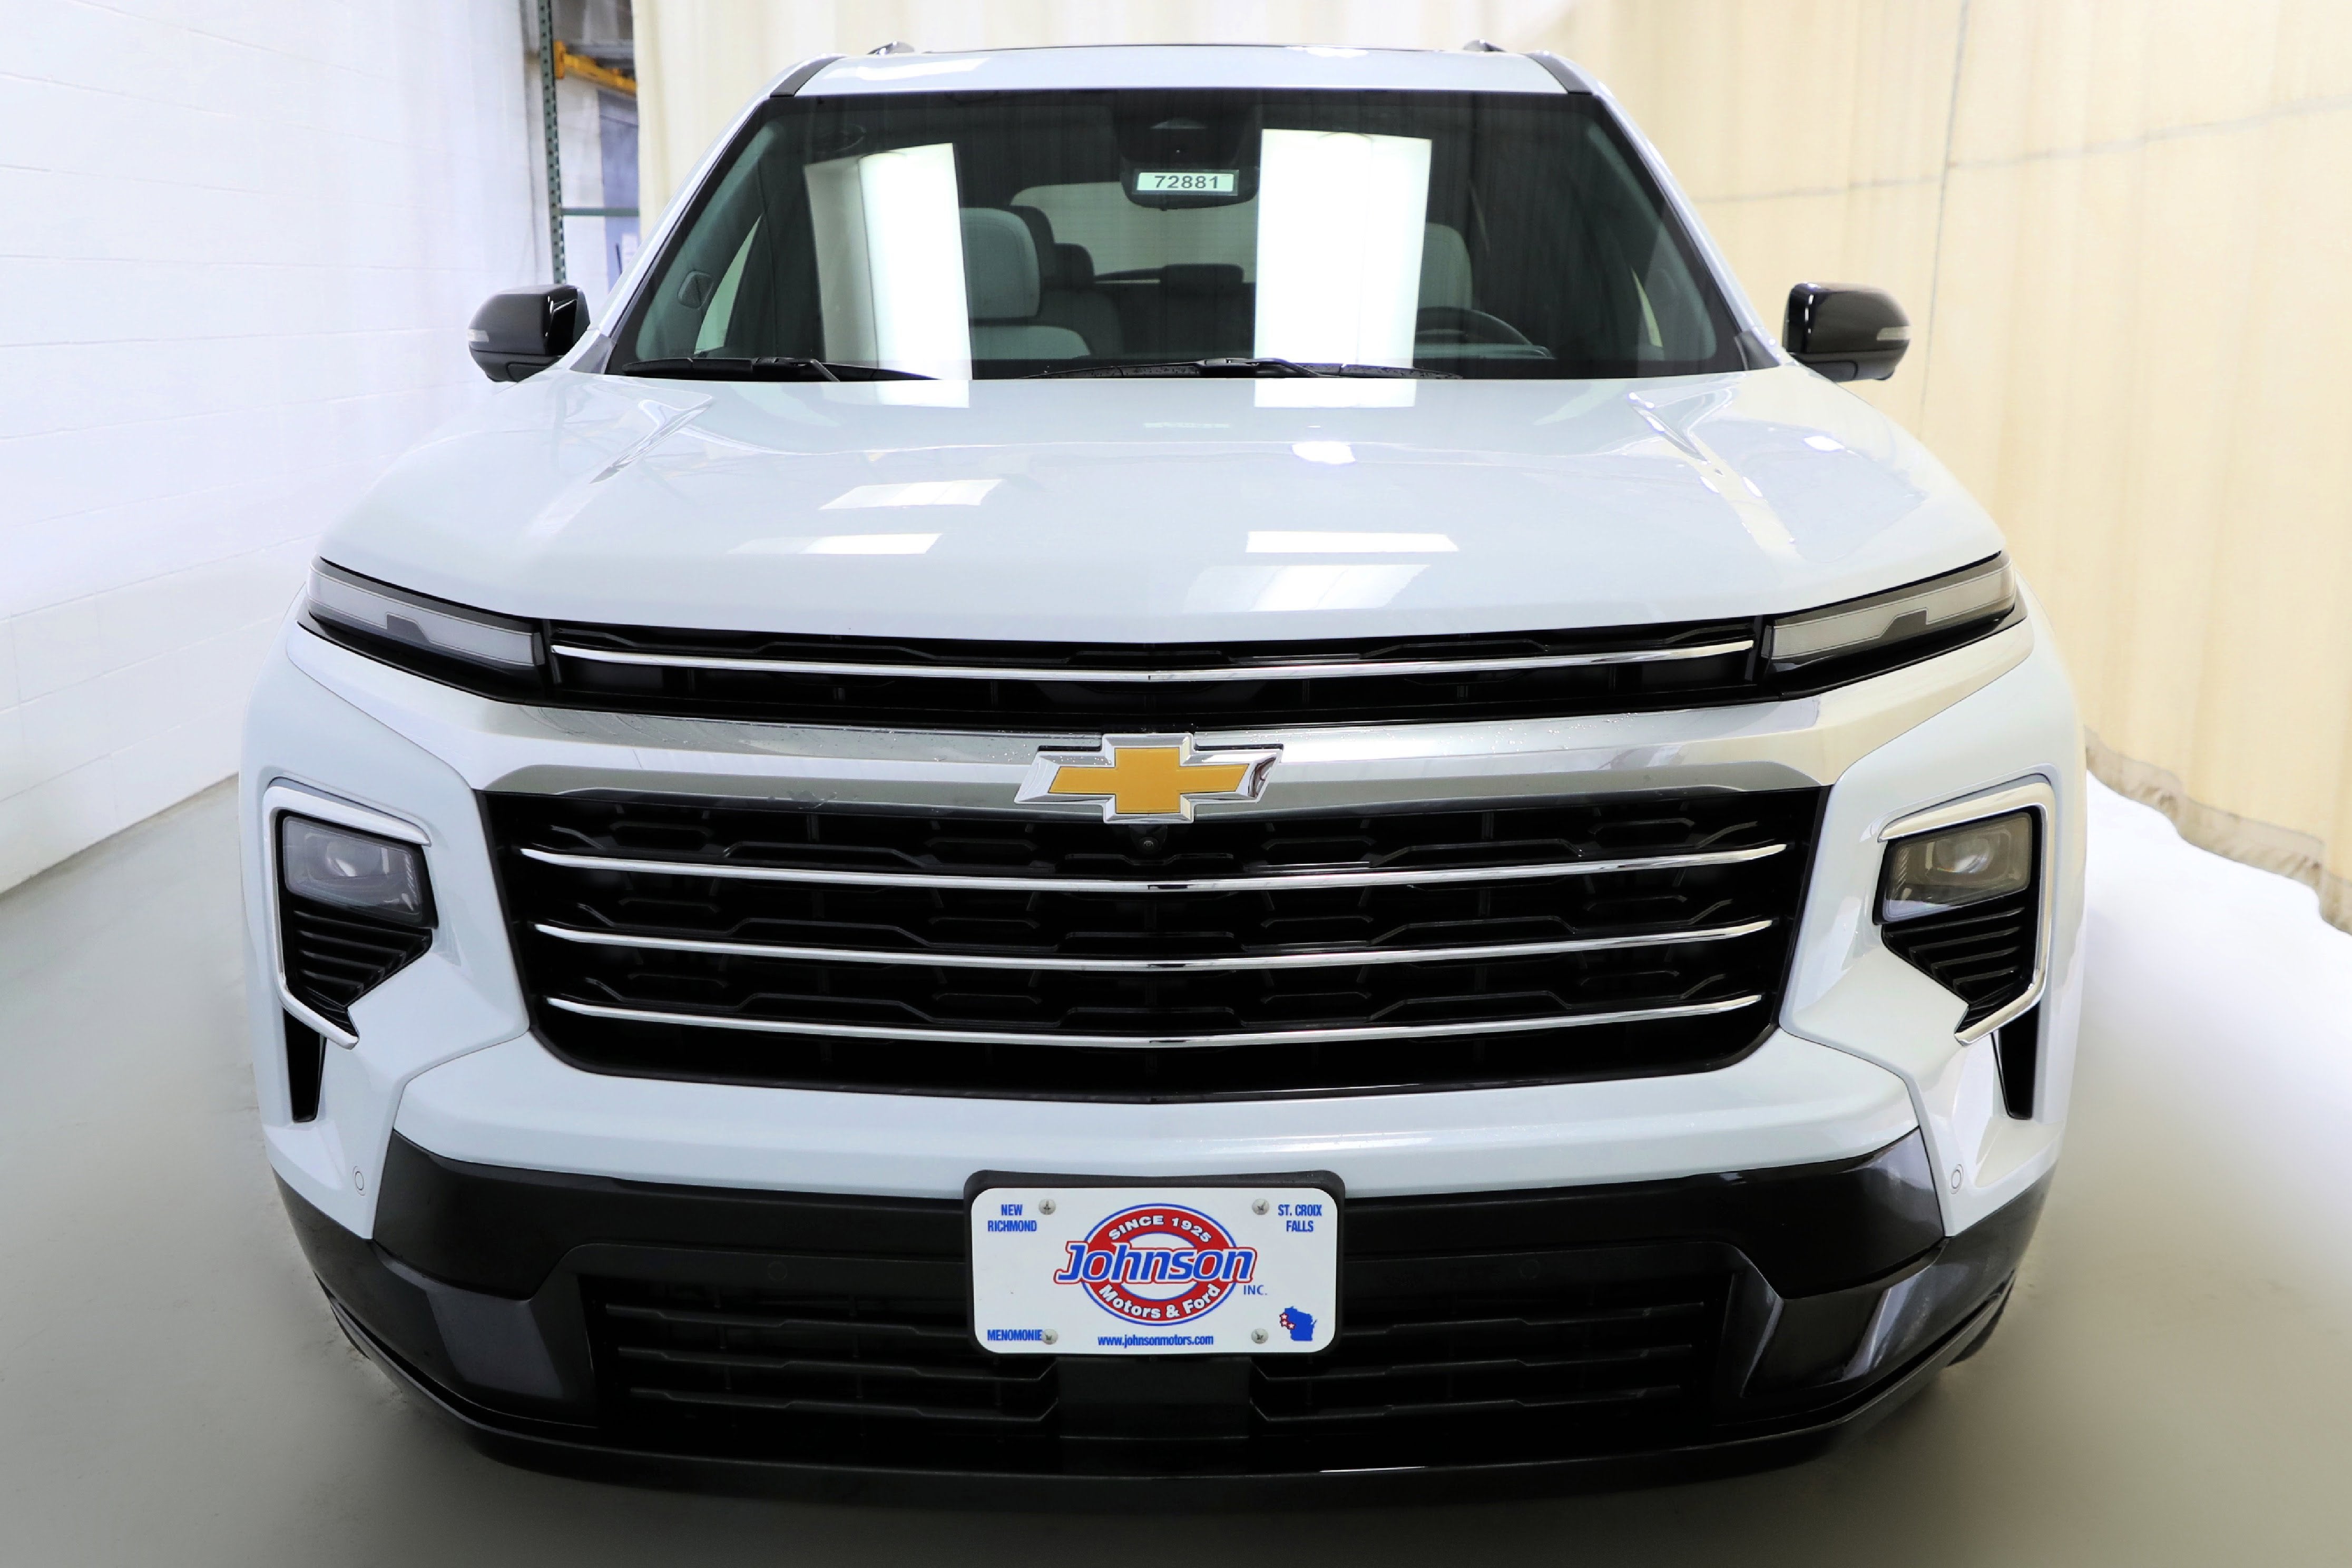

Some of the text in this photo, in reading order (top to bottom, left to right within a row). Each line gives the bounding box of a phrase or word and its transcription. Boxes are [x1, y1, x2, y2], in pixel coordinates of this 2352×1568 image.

[1154, 175, 1219, 189] 72881
[1001, 1204, 1023, 1216] NEW
[1278, 1204, 1322, 1216] ST. CROIX
[987, 1220, 1037, 1232] RICHMOND
[1108, 1215, 1212, 1243] SINCE 1925
[1286, 1220, 1314, 1232] FALLS
[1056, 1243, 1255, 1281] Johnson
[1243, 1285, 1268, 1296] INC.
[1098, 1283, 1221, 1319] Motors & Ford
[987, 1329, 1043, 1341] MENOMONIE
[1097, 1334, 1214, 1349] www.johnsonmotors.com
